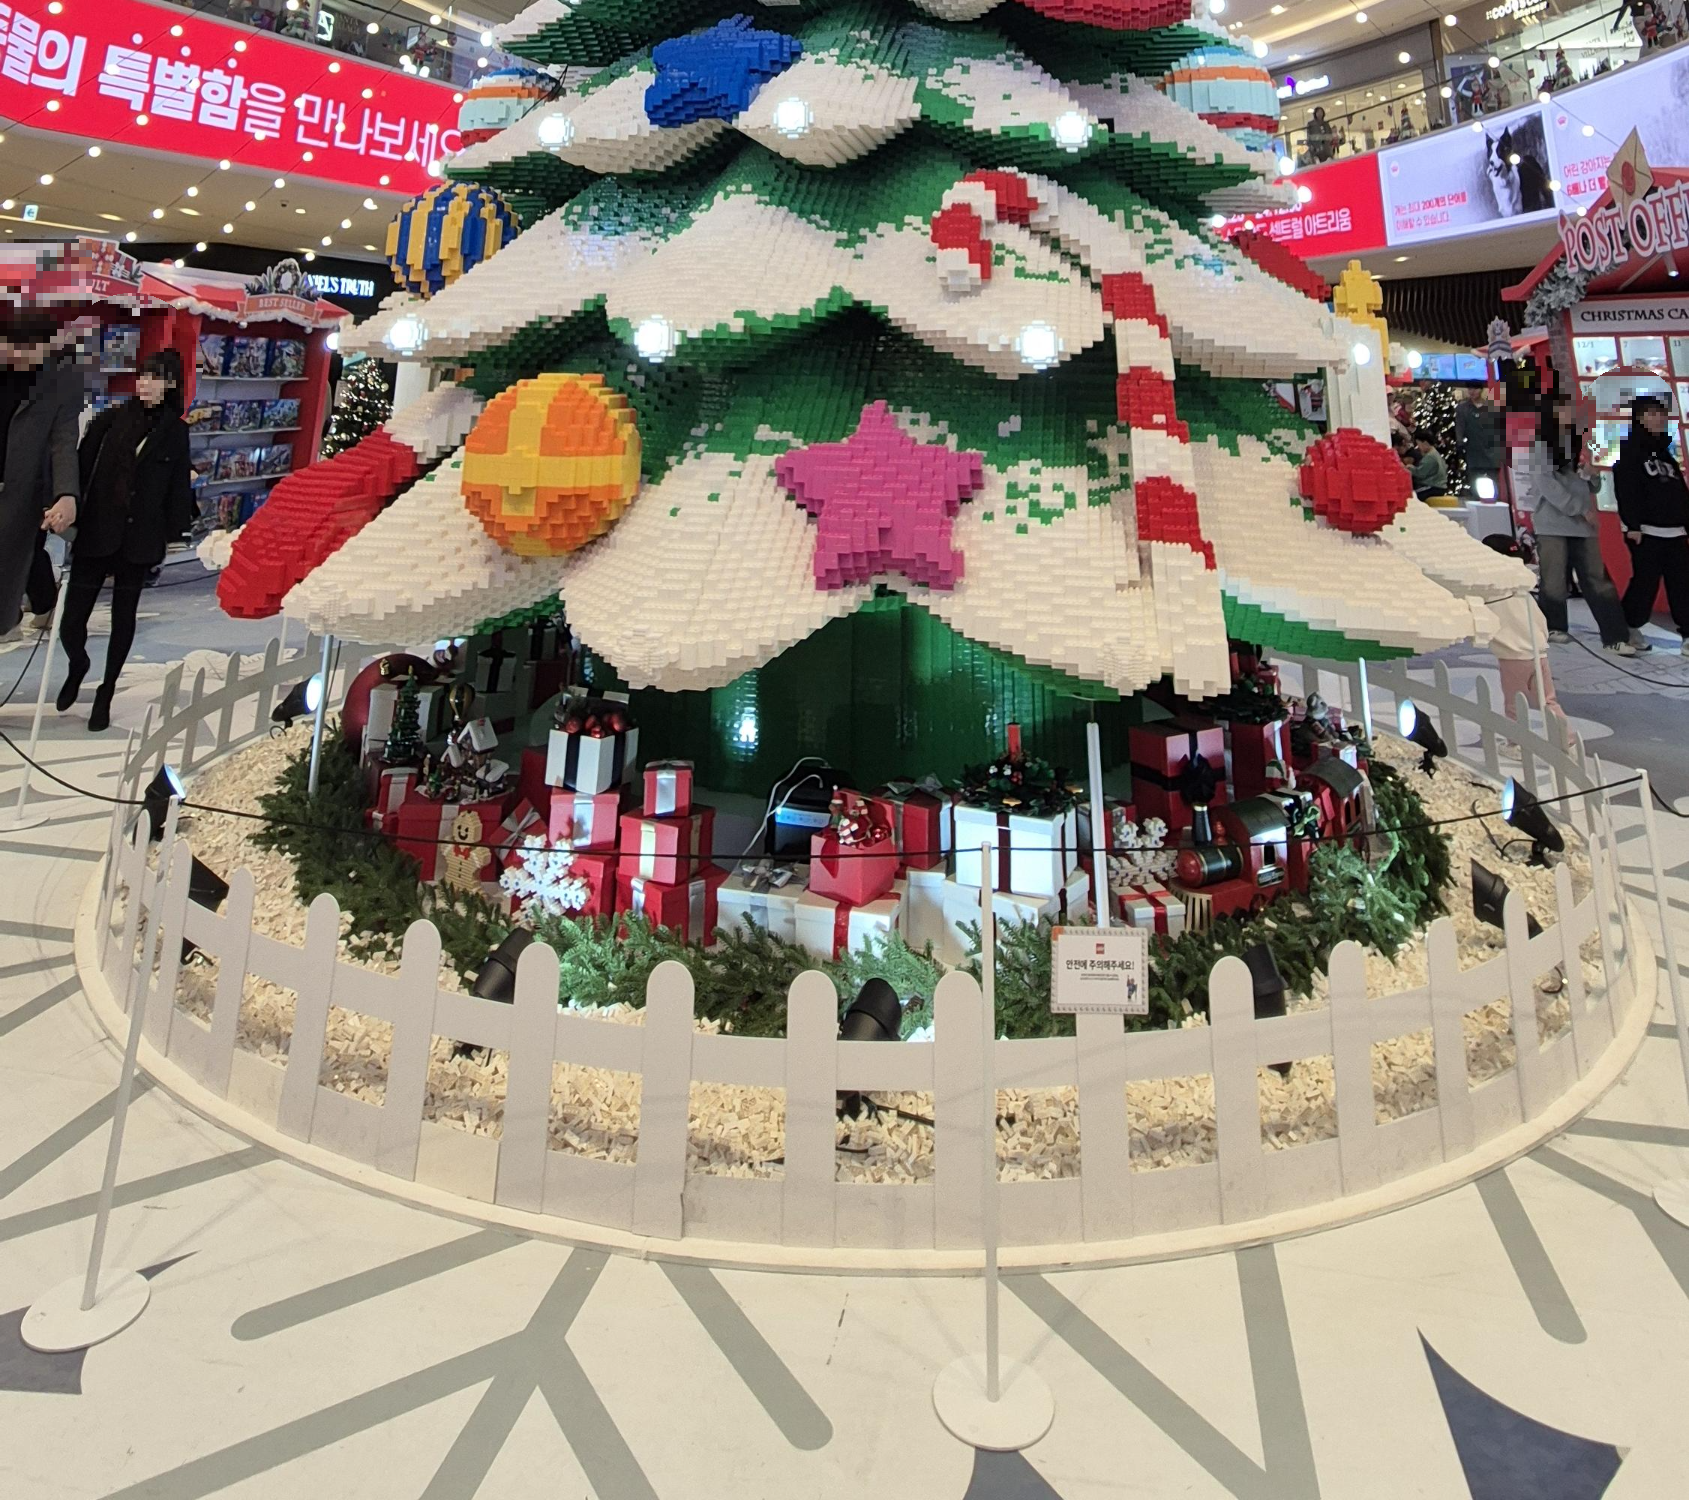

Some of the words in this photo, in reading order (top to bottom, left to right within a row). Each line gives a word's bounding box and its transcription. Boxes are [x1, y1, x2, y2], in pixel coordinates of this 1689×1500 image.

[0, 3, 87, 97] 물의
[99, 43, 286, 139] 특별함을
[1304, 207, 1353, 237] 아트리움
[1564, 208, 1629, 271] POST
[340, 277, 375, 297] TRUTH
[258, 298, 278, 308] BEST
[280, 299, 306, 311] SELLER
[1580, 308, 1665, 322] CHRISTMAS
[1065, 959, 1087, 970] 안전에
[1089, 960, 1135, 970] 주의해주세요!
